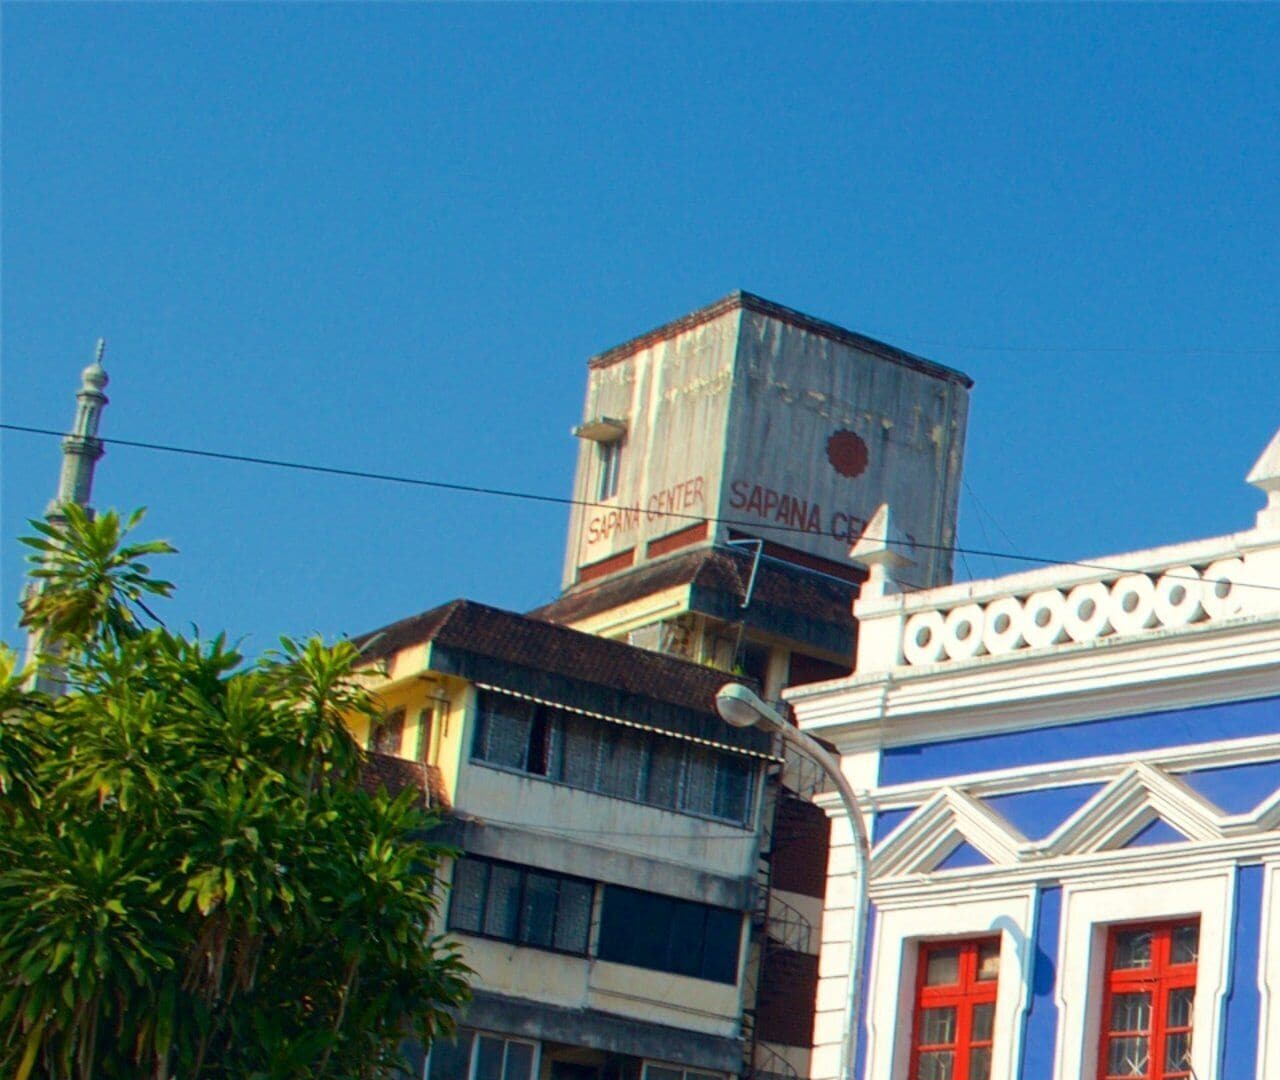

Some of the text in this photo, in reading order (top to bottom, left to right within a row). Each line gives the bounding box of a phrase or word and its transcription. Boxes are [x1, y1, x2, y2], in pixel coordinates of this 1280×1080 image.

[587, 475, 704, 545] SAPANA CENTER
[730, 480, 822, 535] SAPANA
